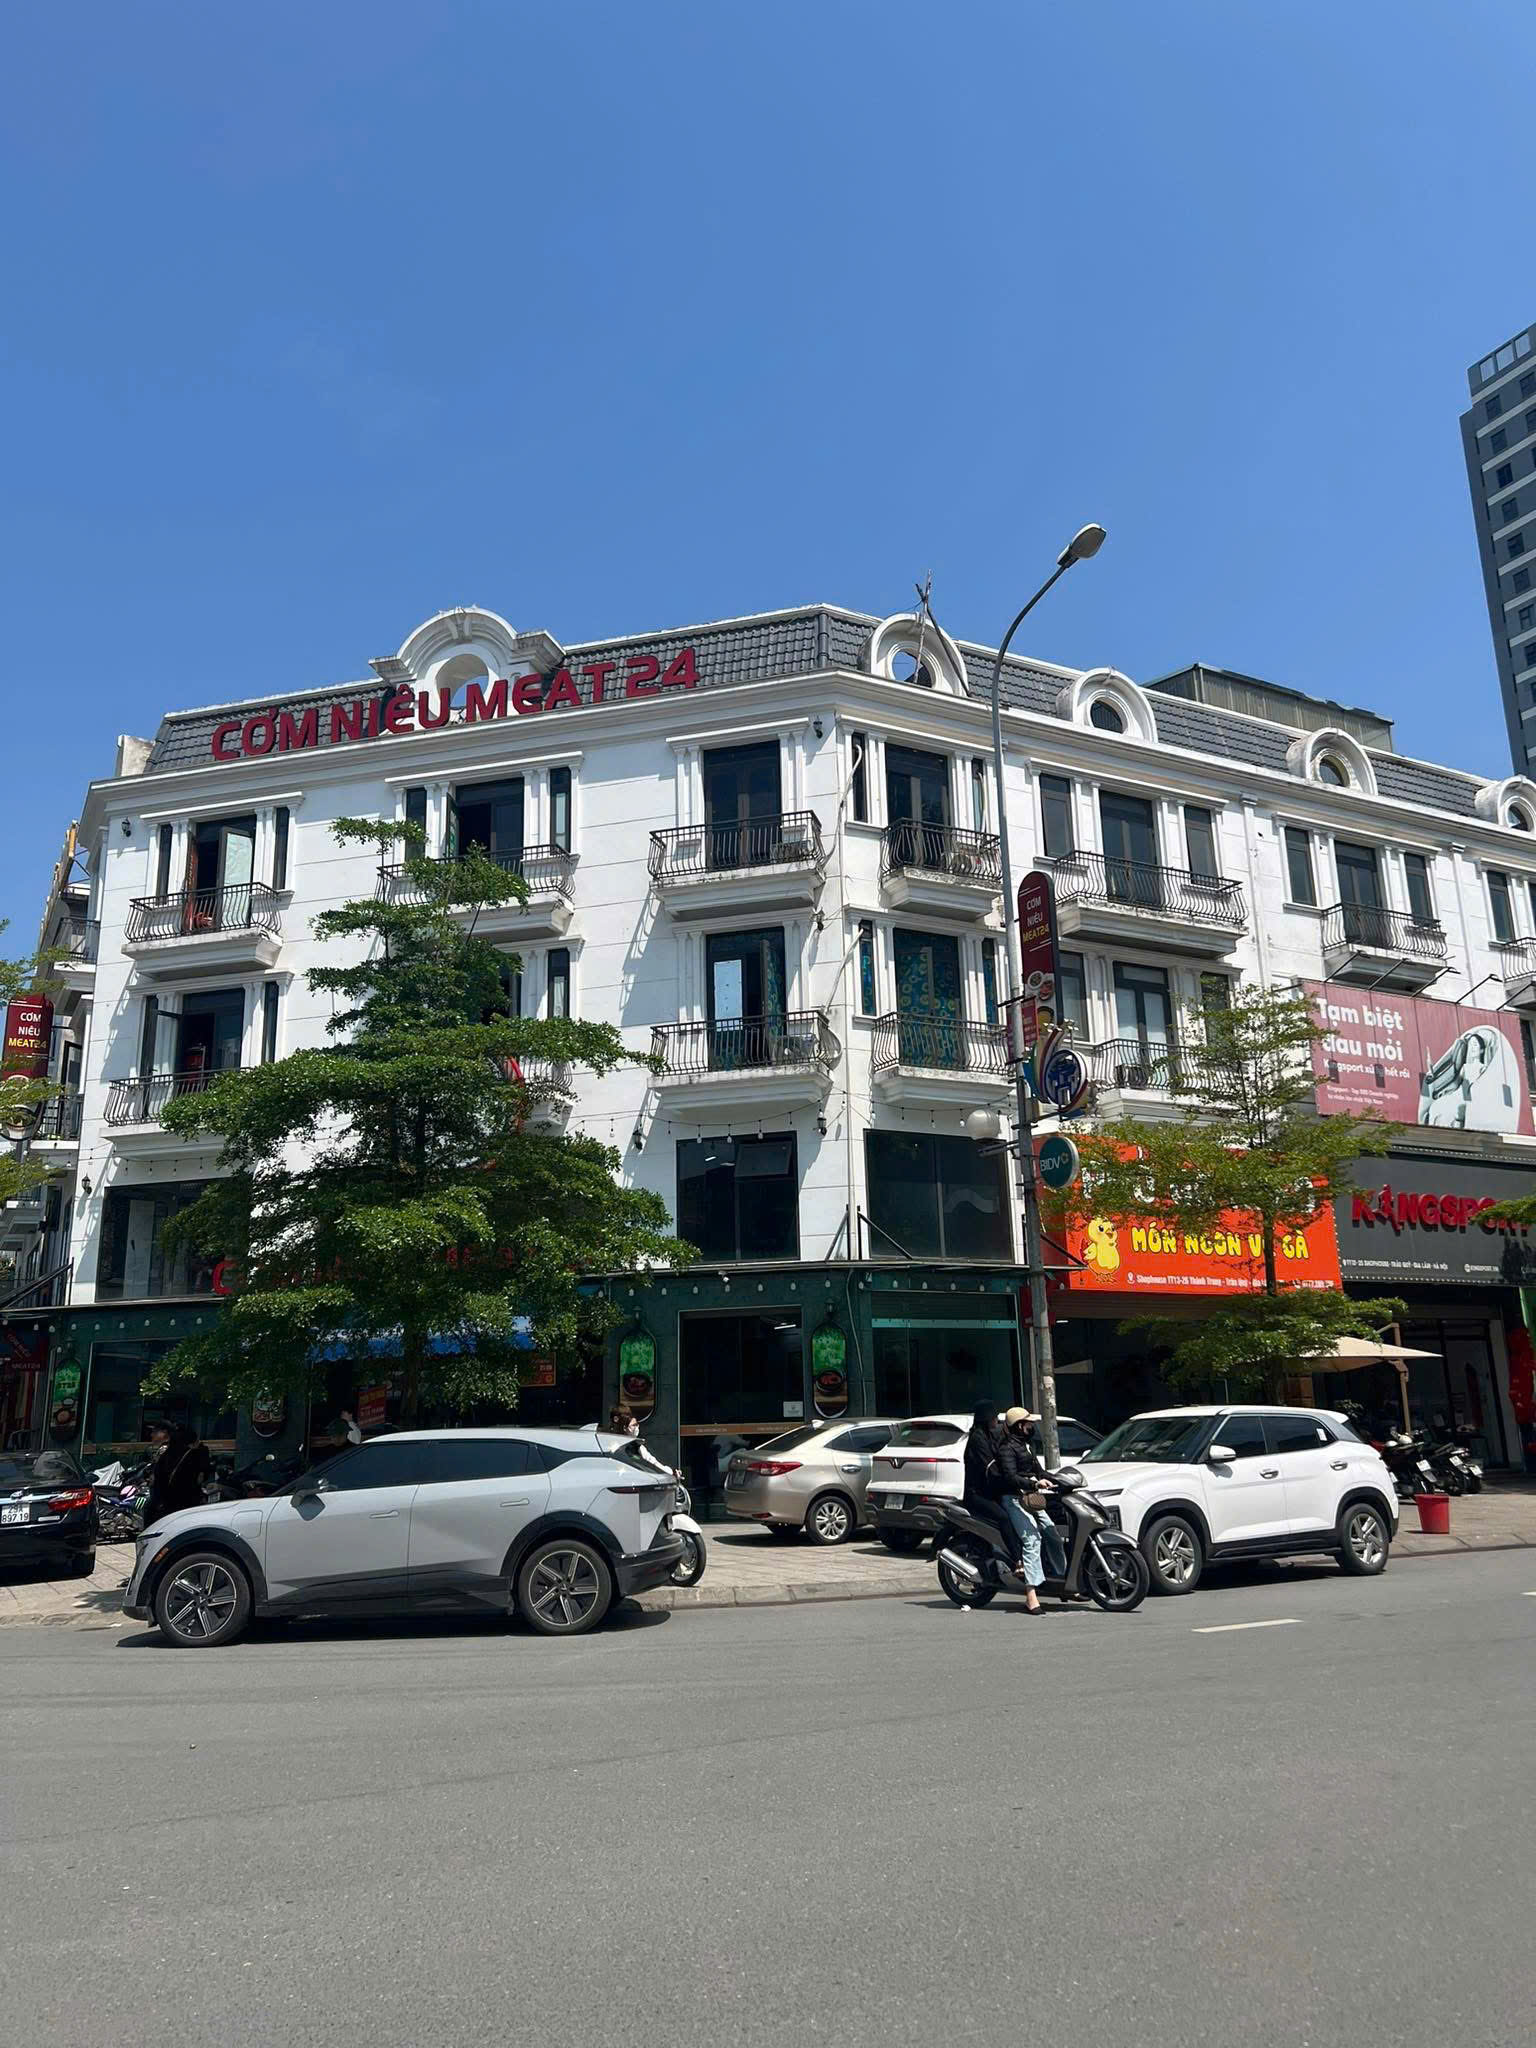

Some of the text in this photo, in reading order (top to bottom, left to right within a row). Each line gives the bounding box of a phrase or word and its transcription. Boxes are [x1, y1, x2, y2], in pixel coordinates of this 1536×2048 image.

[212, 648, 701, 761] CƠM NIÊU MEAT 24
[20, 1012, 42, 1022] CƠM
[1316, 998, 1404, 1035] Tạm biệt
[18, 1025, 41, 1036] NIÊU
[8, 1037, 47, 1049] MEAT24
[1366, 1038, 1403, 1062] mỏi
[1040, 1156, 1060, 1171] BIDV
[1131, 1221, 1177, 1254] MÓN
[1282, 1229, 1310, 1259] GÀ
